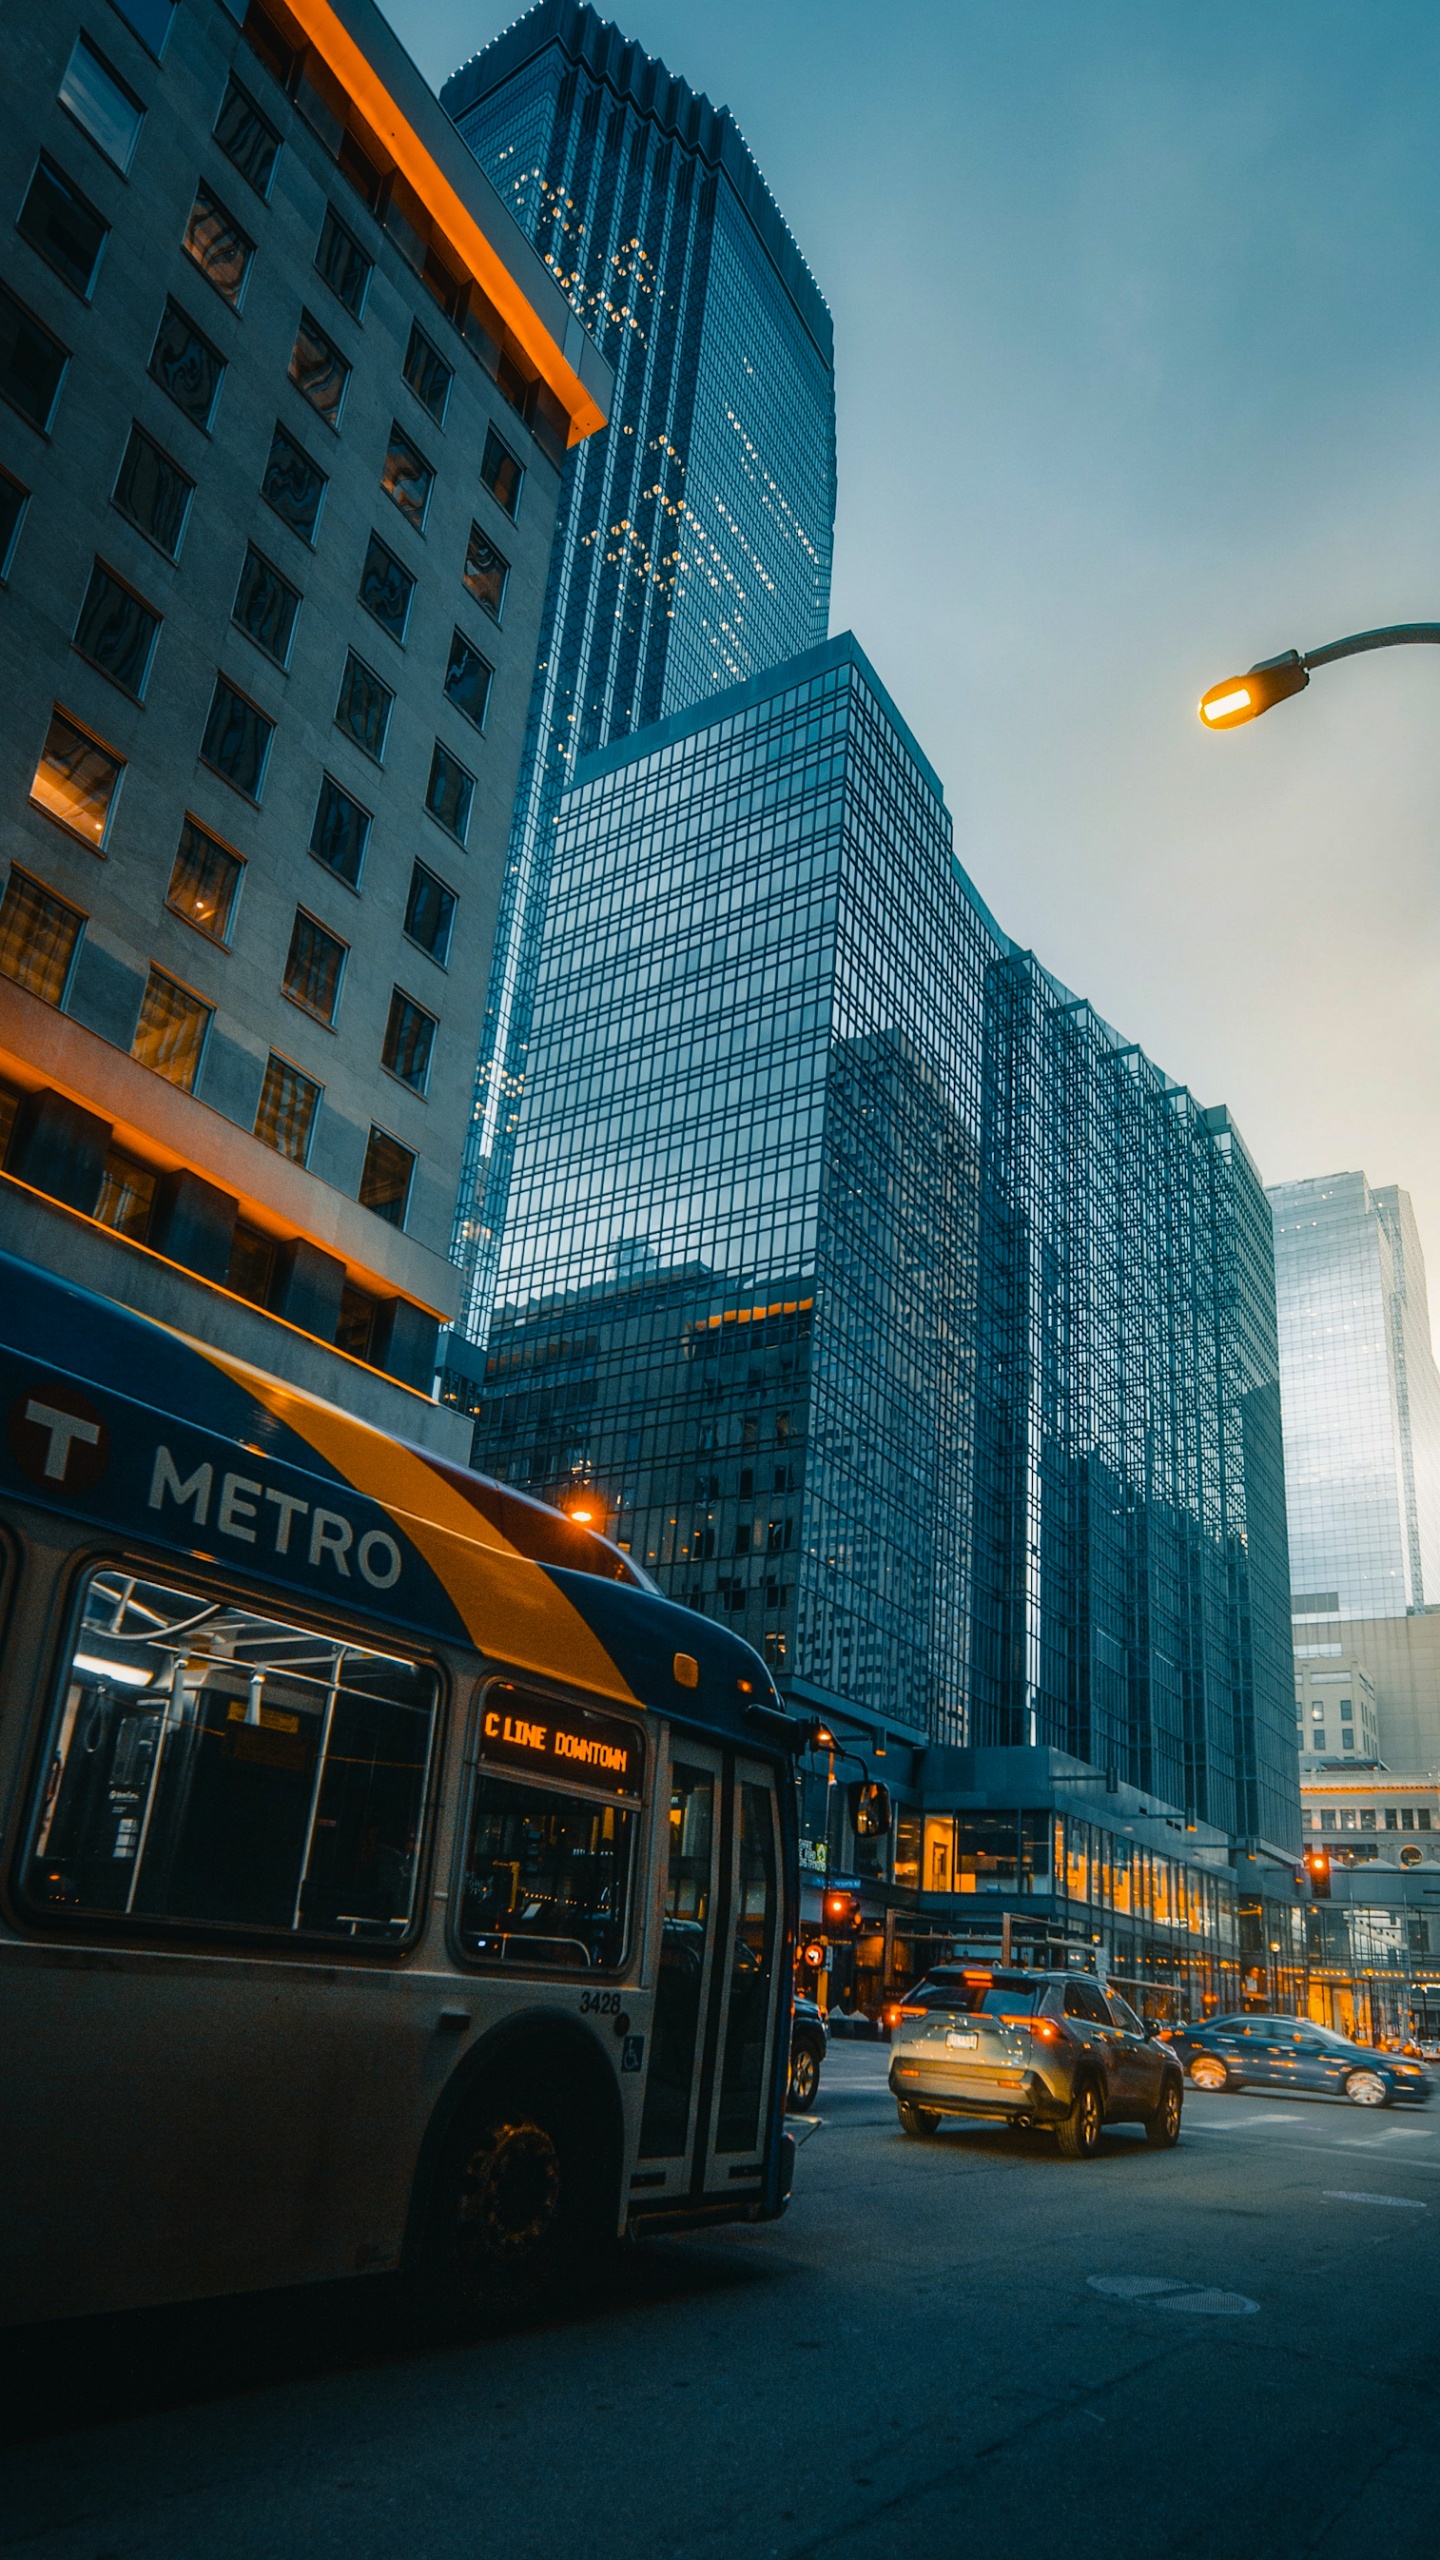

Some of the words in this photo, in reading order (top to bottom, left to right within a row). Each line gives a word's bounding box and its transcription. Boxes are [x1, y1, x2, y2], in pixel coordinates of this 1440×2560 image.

[25, 1398, 100, 1480] T
[147, 1444, 403, 1590] METRO
[484, 1712, 500, 1737] C
[504, 1718, 546, 1749] LINE
[556, 1733, 627, 1771] DOWNTOWN
[581, 1992, 621, 2014] 3428
